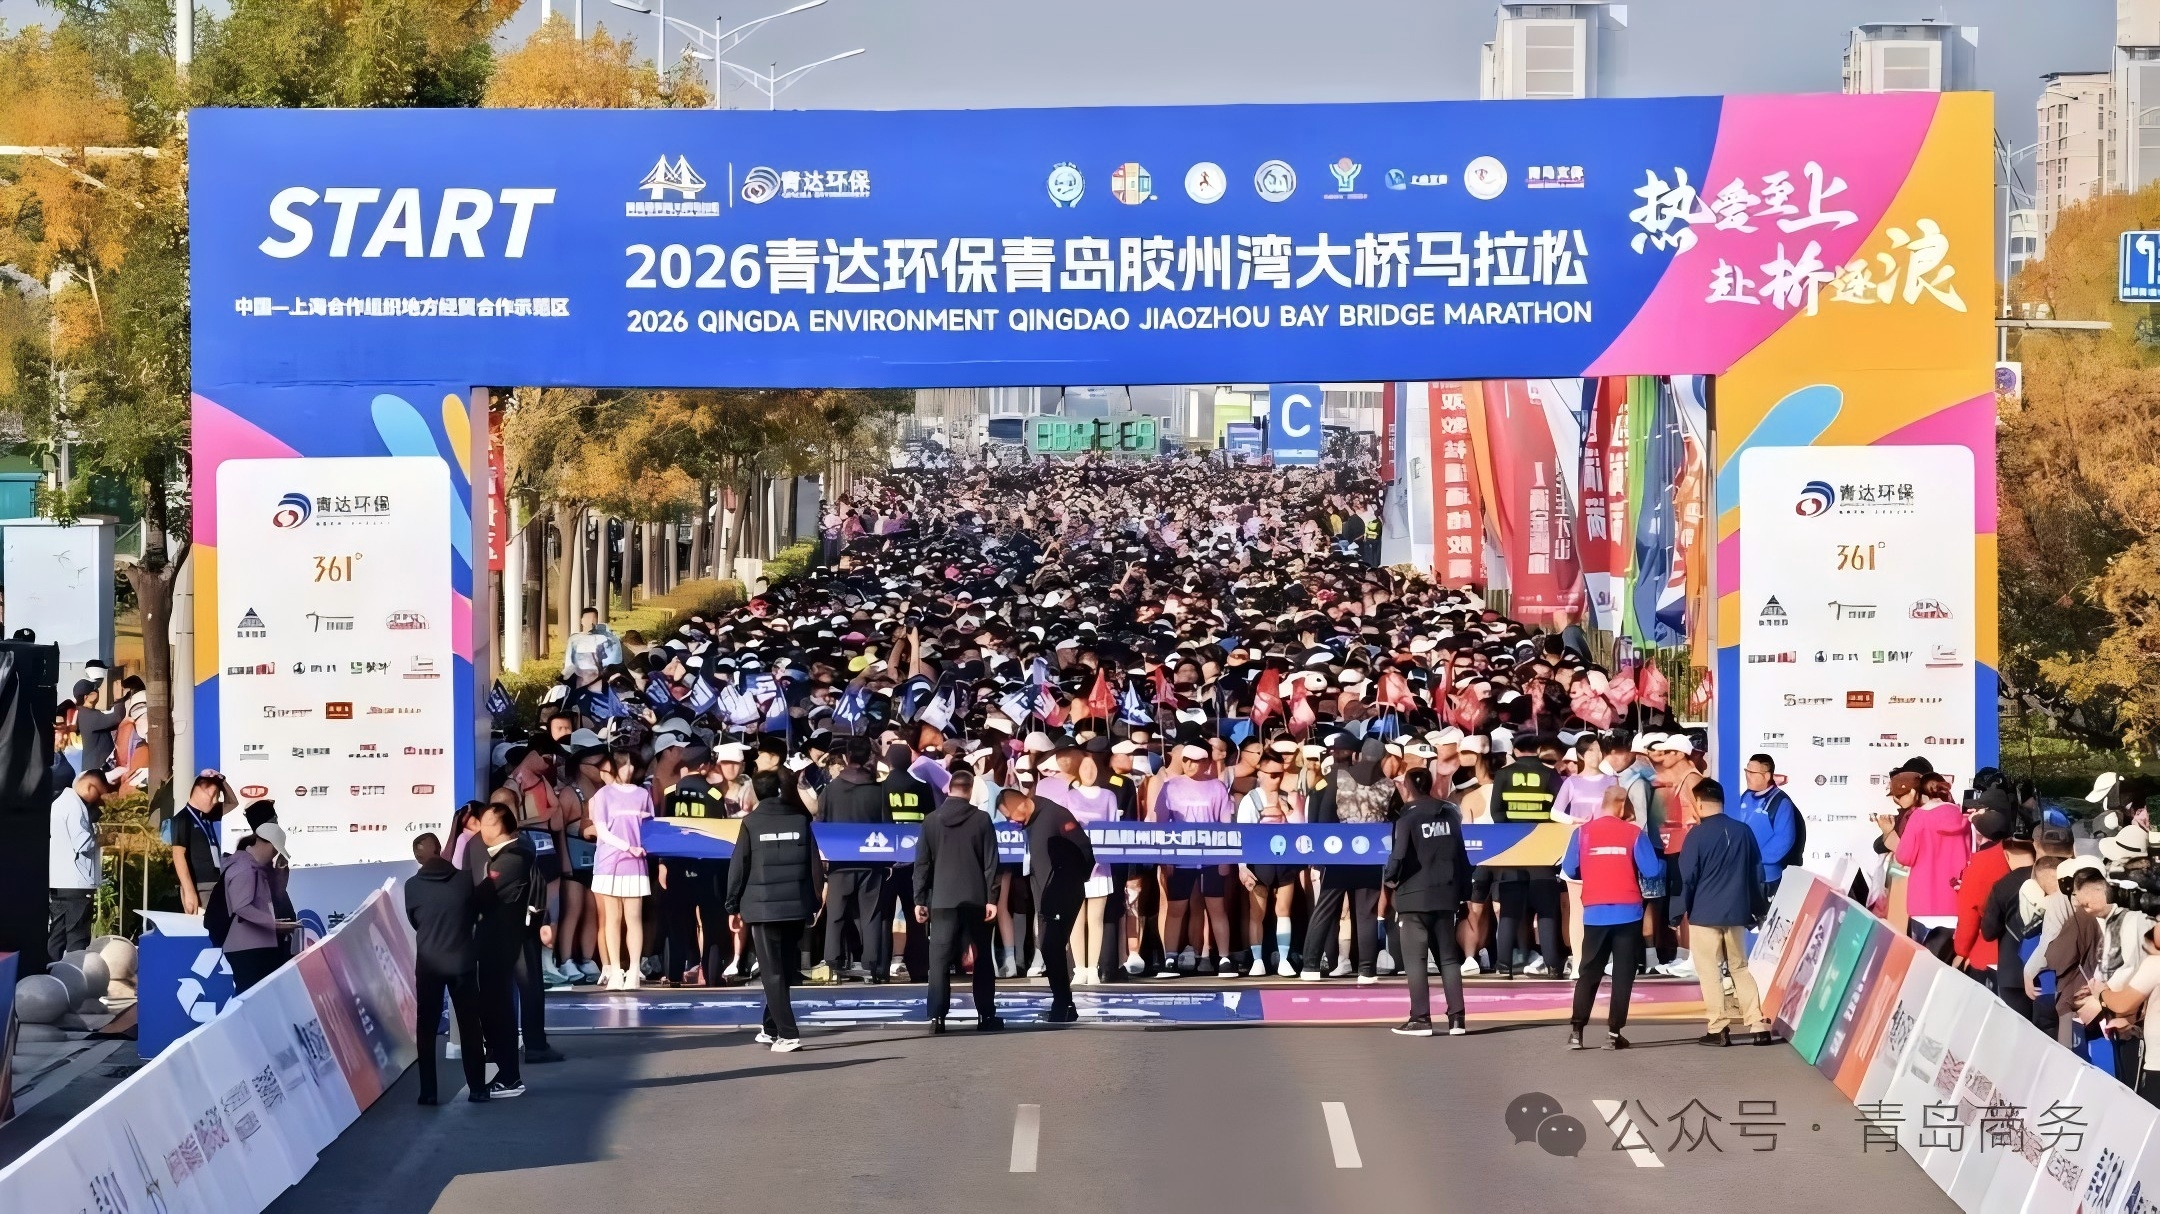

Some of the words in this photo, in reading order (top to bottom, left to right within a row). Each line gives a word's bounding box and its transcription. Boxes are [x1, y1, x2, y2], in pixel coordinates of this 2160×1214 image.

[258, 186, 557, 259] START
[625, 230, 1589, 294] 2026青达环保青岛胶州湾大桥马拉松
[627, 309, 689, 333] 2026
[698, 309, 800, 334] QINGDA
[809, 308, 999, 332] ENVIRONMENT
[1008, 306, 1130, 331] QINGDAO
[1139, 304, 1270, 330] JIAOZHOU
[1280, 304, 1330, 327] BAY
[1339, 302, 1435, 327] BRIDGE
[1444, 301, 1593, 325] MARATHON
[1281, 394, 1312, 438] C
